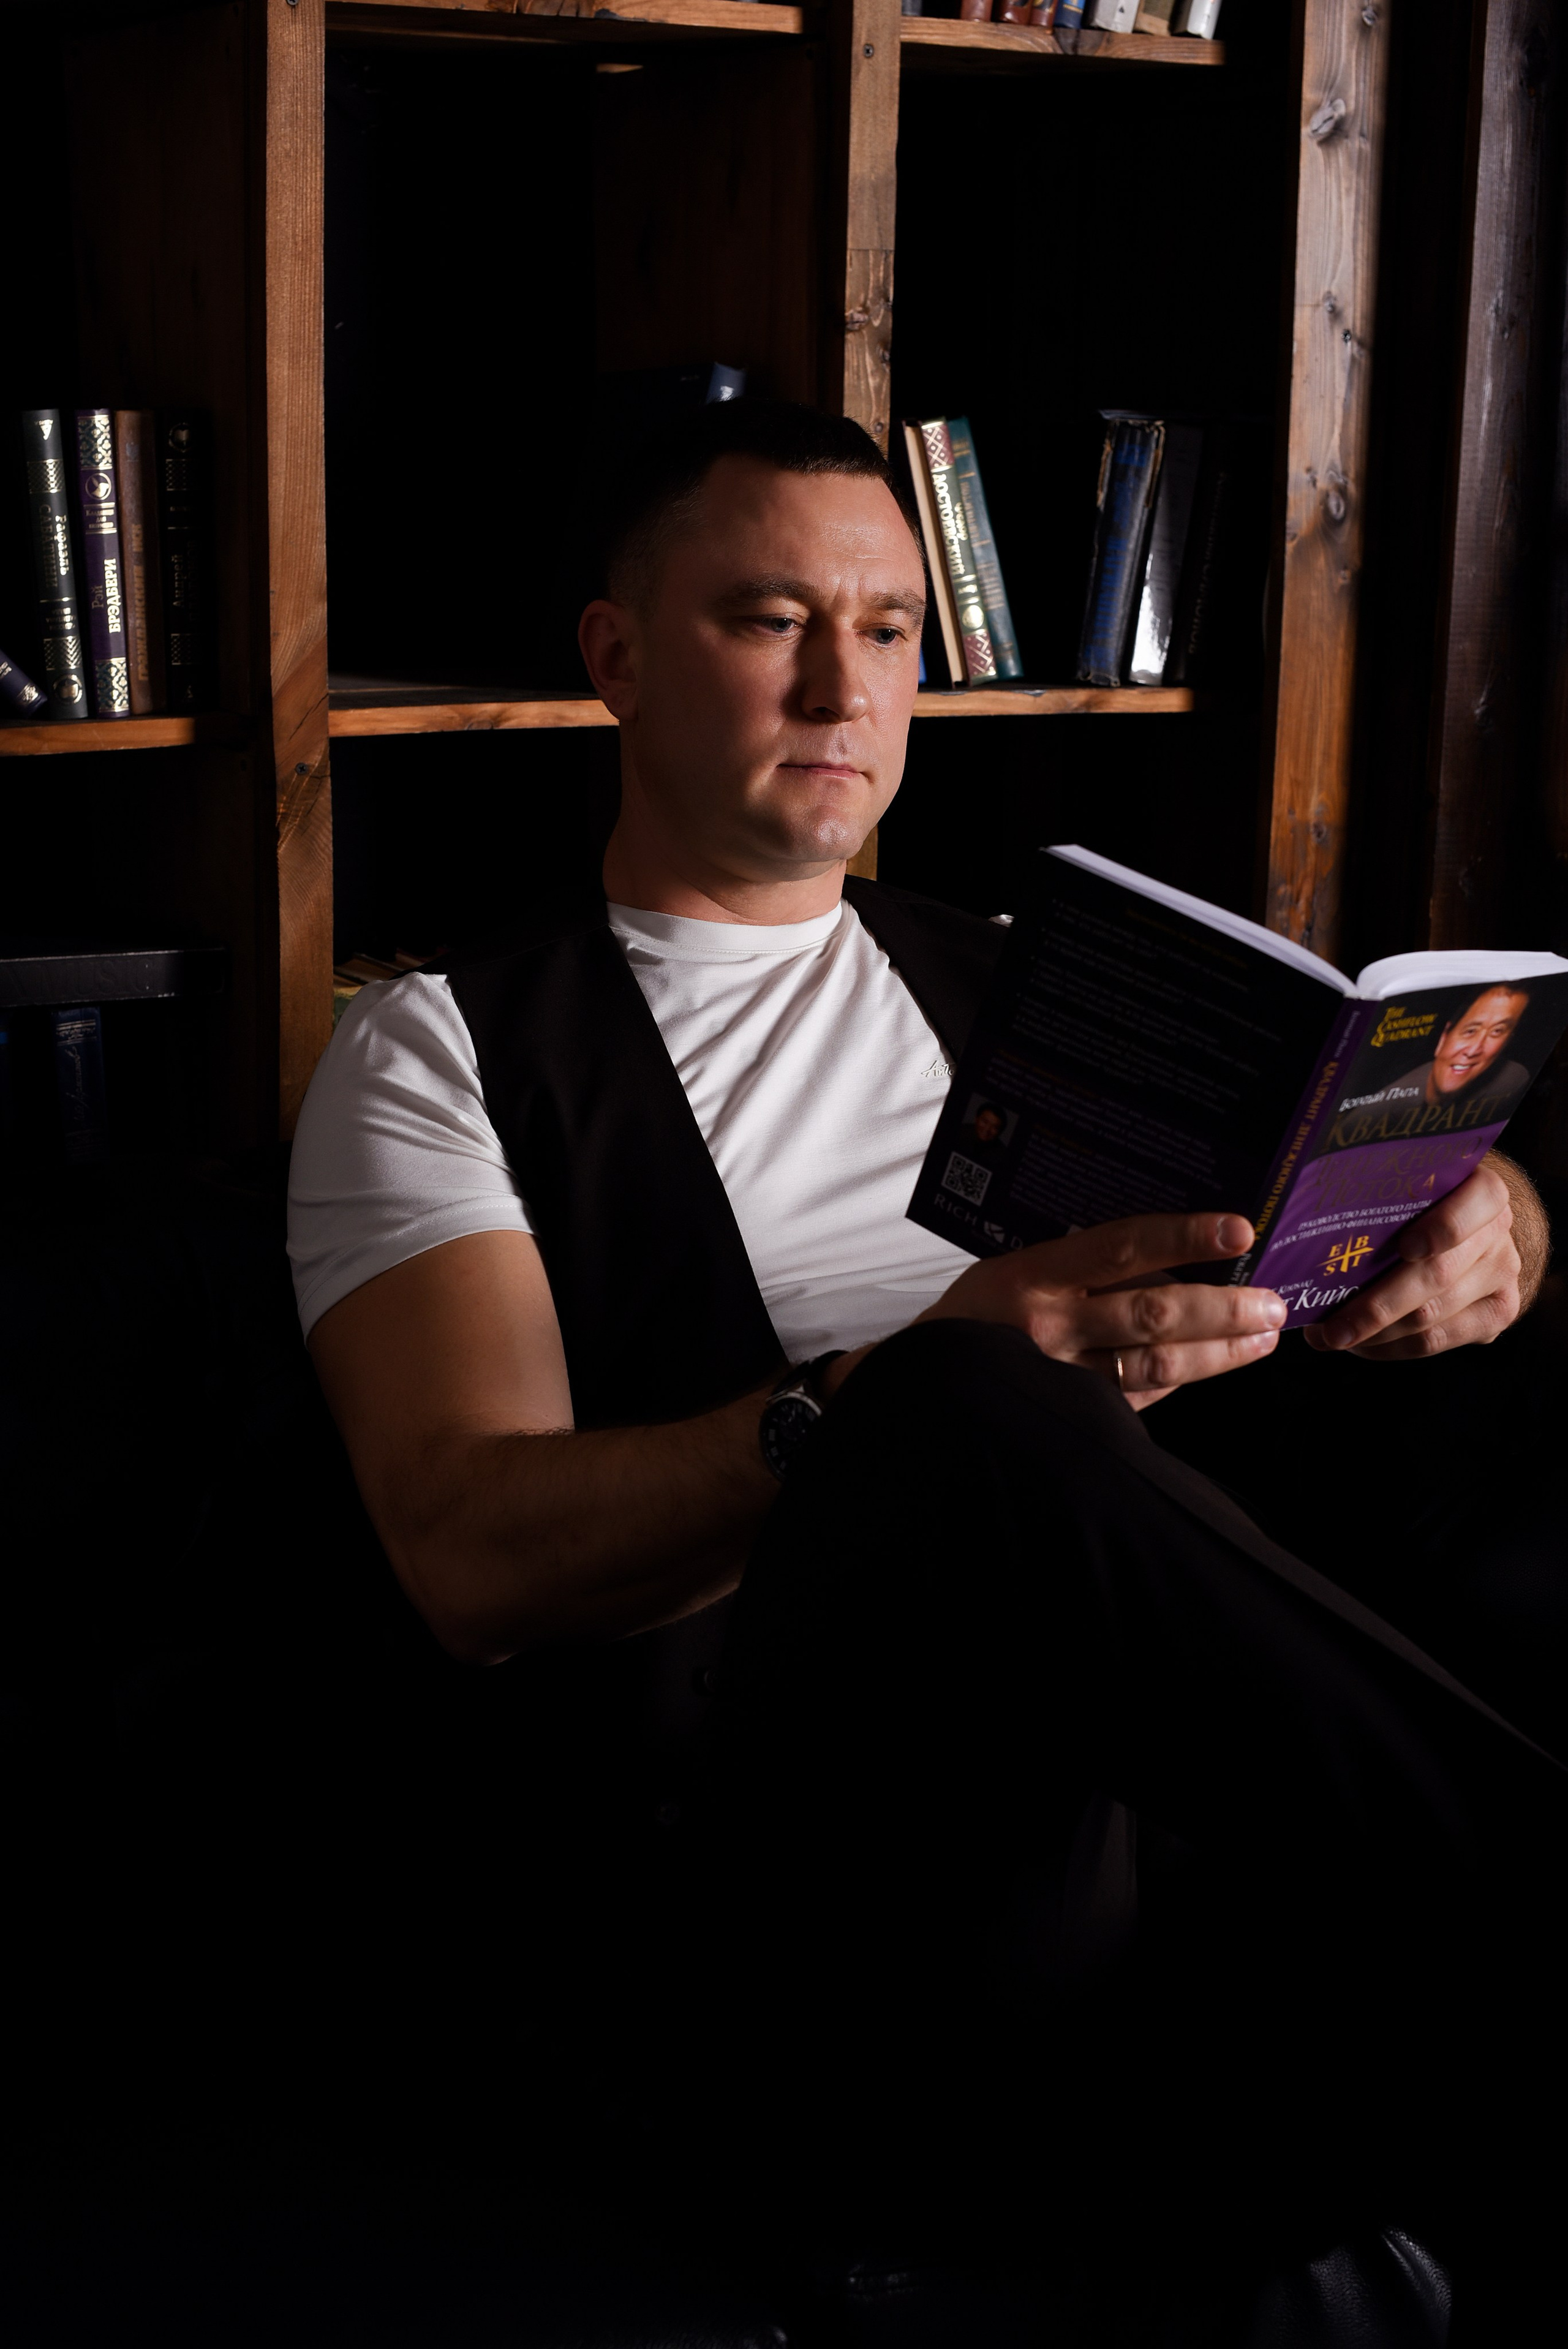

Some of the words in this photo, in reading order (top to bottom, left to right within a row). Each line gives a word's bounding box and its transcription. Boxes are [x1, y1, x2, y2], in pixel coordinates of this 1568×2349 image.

[39, 503, 57, 587] САБАТИНИ
[55, 515, 69, 575] Рафаэль
[932, 473, 965, 575] ДОСТОЕВСКИЙ
[91, 585, 104, 609] Рэй
[104, 559, 121, 633] БРЭДБЕРИ
[172, 554, 187, 607] Андрей
[1321, 1095, 1507, 1153] КВАДРАНТ
[1323, 1263, 1337, 1276] S
[1351, 1255, 1362, 1267] I
[1328, 1243, 1343, 1257] E
[1354, 1235, 1370, 1249] B
